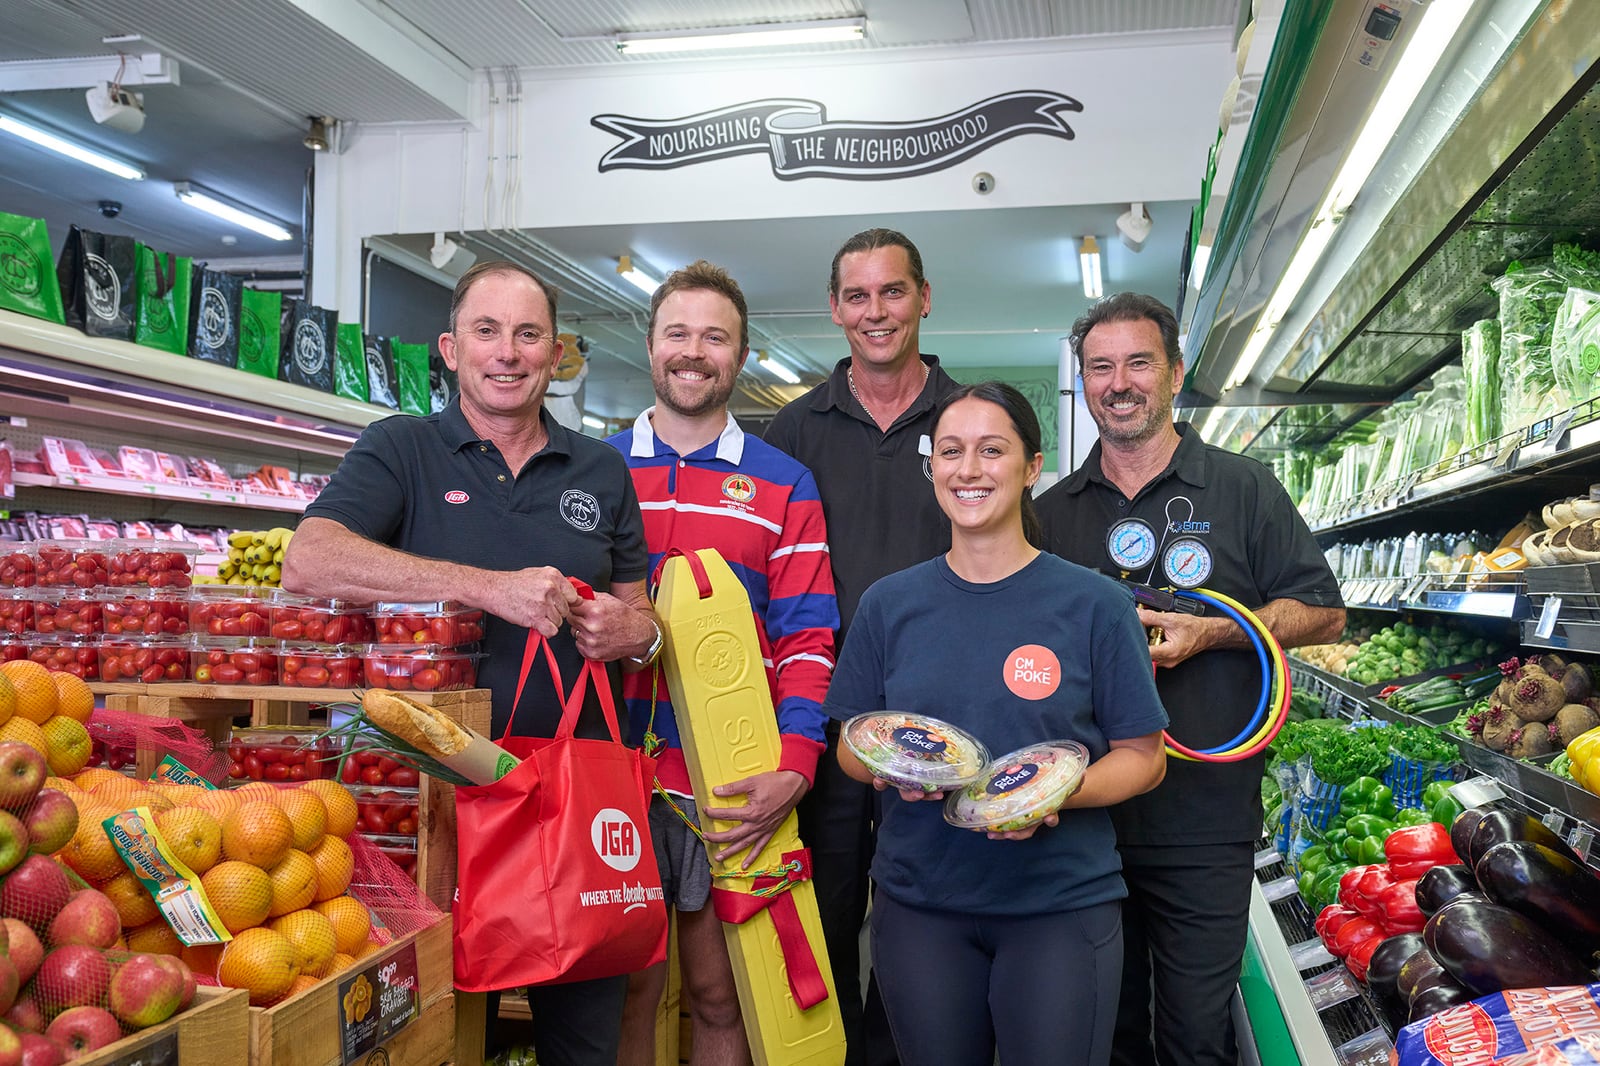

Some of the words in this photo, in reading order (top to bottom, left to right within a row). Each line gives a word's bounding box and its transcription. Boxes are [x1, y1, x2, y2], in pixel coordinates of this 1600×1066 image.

[649, 115, 761, 158] NOURISHING
[792, 136, 826, 162] THE
[834, 112, 988, 163] NEIGHBOURHOOD
[448, 493, 466, 501] IGA
[1183, 520, 1211, 531] BMR
[1014, 664, 1052, 685] POKÉ
[1015, 657, 1035, 670] CM
[905, 730, 924, 740] CM
[994, 775, 1011, 787] CM
[109, 824, 135, 849] BROS
[601, 821, 635, 856] IGA
[130, 848, 167, 882] LOCHERT
[579, 890, 610, 907] WHERE
[609, 889, 623, 904] THE
[623, 880, 646, 904] locals
[645, 887, 664, 901] MATTE
